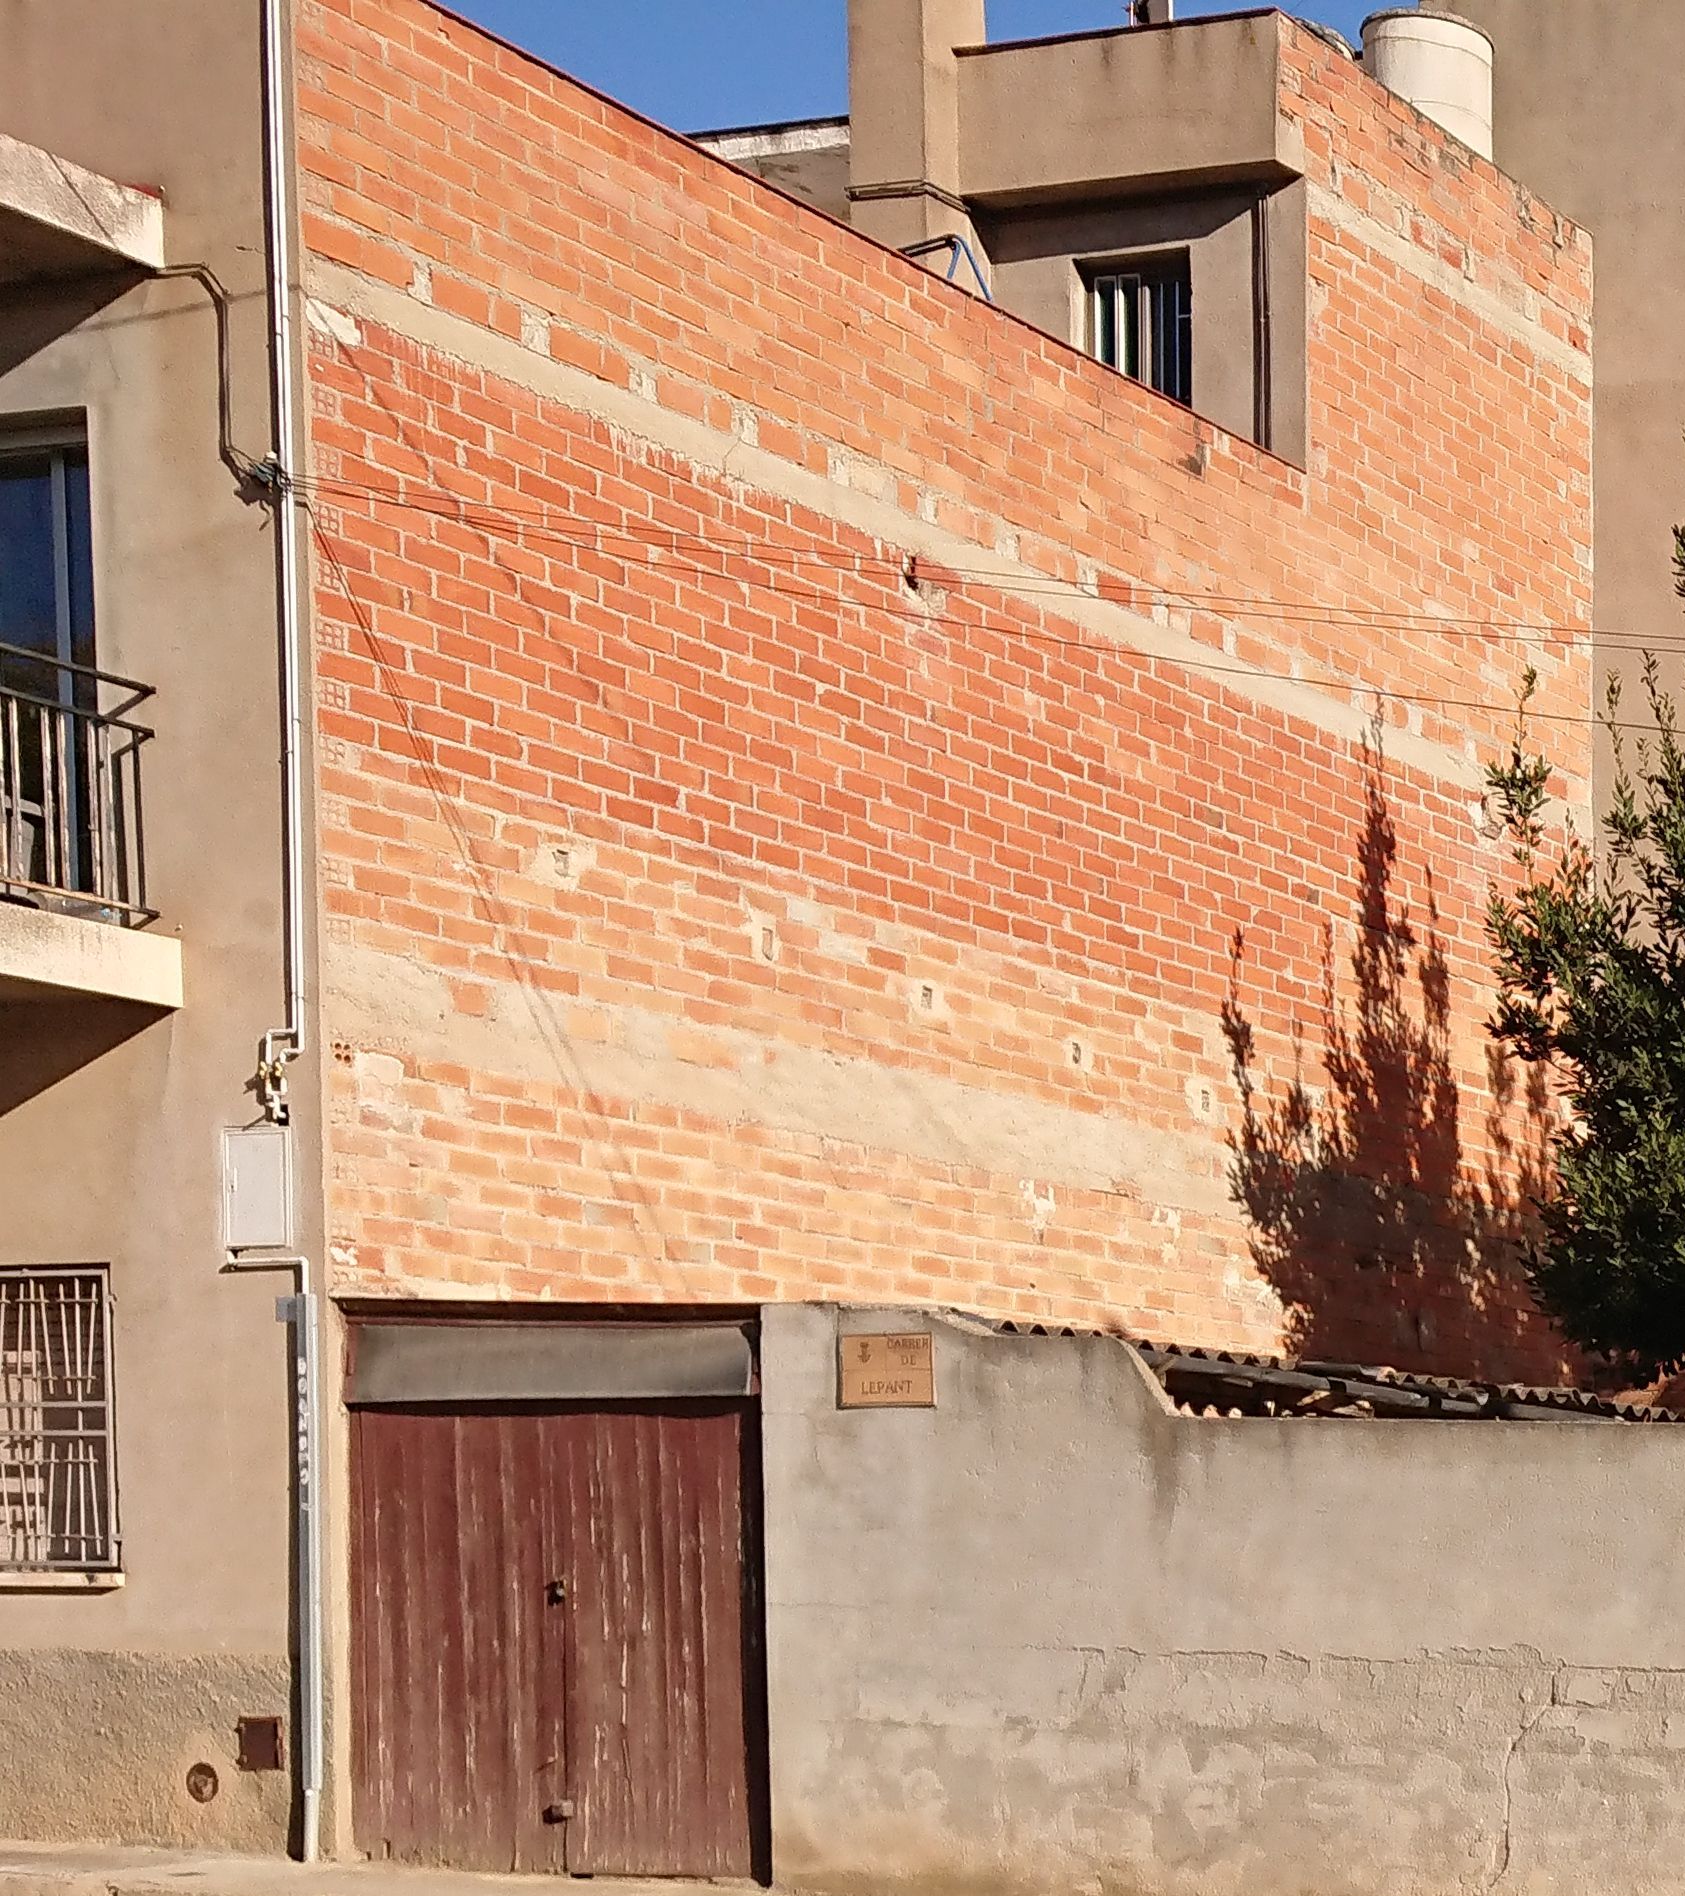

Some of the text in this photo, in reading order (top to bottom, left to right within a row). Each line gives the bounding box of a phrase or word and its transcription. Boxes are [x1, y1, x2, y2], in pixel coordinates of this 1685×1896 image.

[886, 1337, 929, 1350] CARRER
[900, 1354, 917, 1366] DE
[861, 1380, 913, 1395] LEPANT
